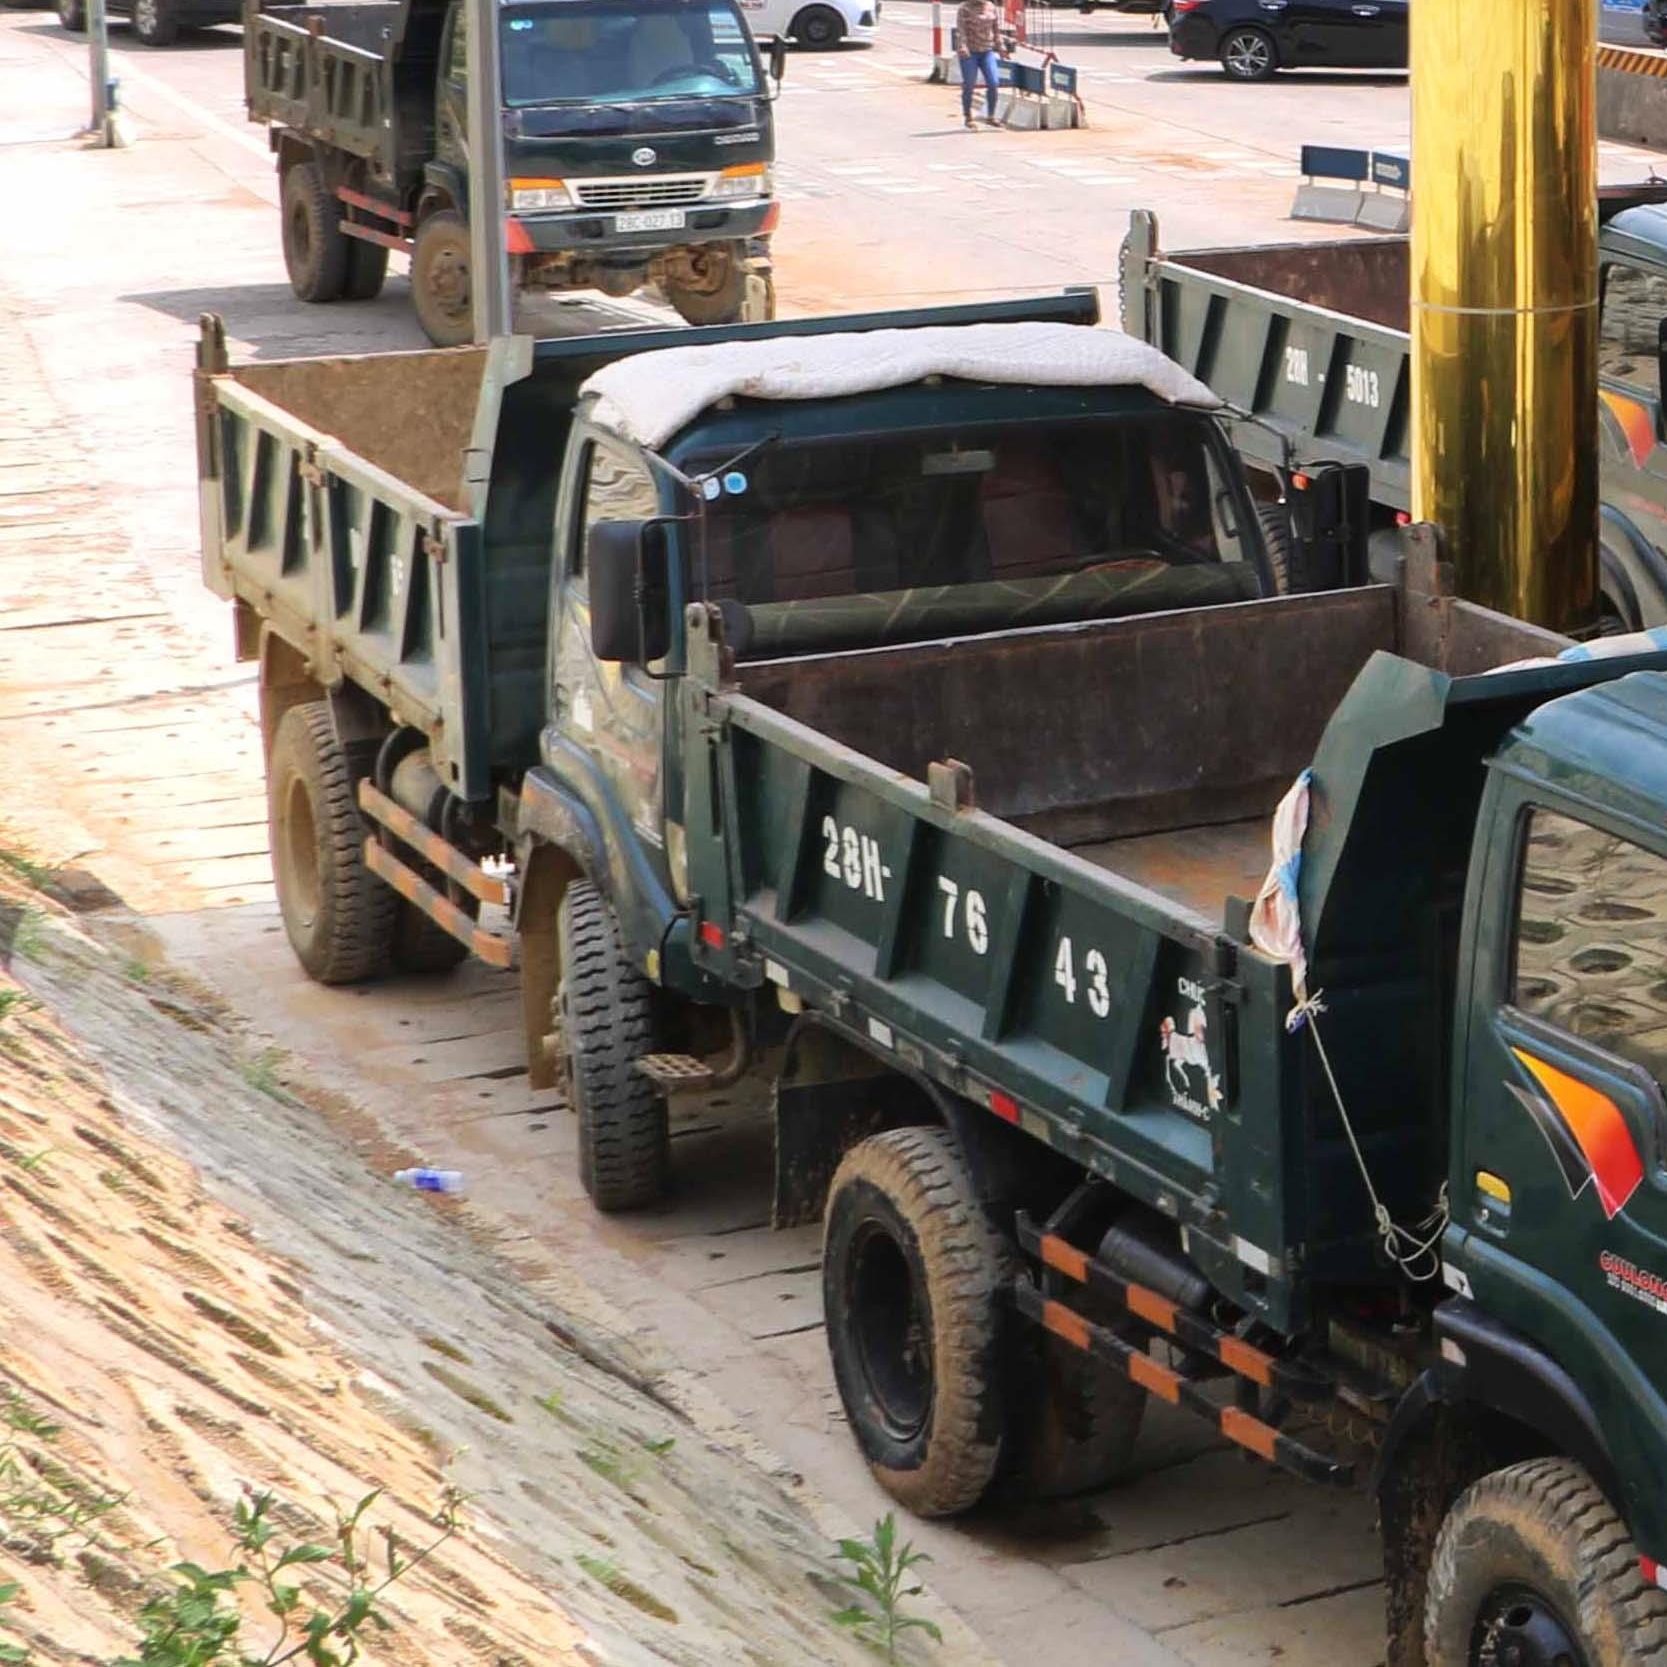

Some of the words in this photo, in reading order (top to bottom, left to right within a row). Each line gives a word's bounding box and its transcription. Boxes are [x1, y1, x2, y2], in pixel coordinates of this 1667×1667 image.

[1346, 364, 1379, 408] 5013
[938, 875, 989, 955] 76
[1055, 937, 1111, 1018] 43
